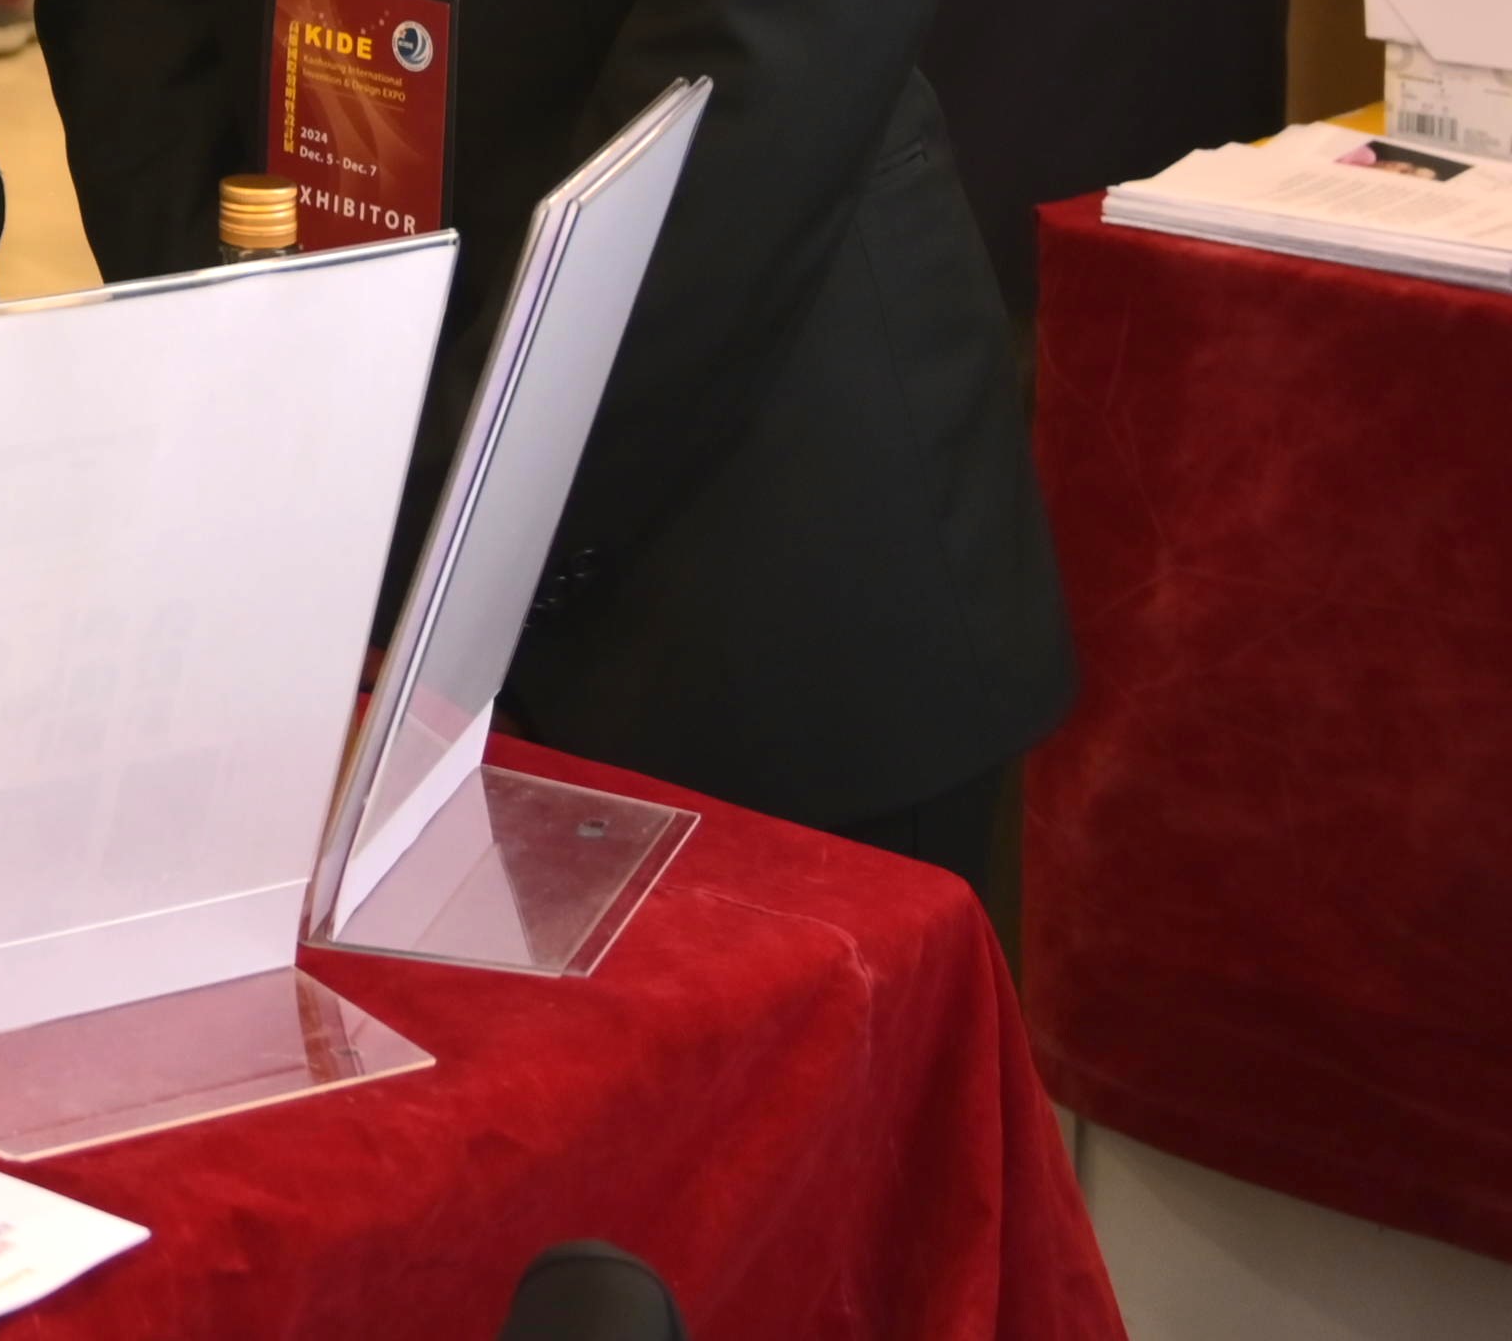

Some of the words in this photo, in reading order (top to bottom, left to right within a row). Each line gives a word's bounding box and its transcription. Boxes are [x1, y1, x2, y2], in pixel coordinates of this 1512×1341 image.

[304, 23, 373, 60] KIDE
[300, 126, 328, 144] 2024
[299, 144, 324, 164] Dec.
[326, 153, 334, 166] 5
[342, 157, 367, 176] Dec.
[370, 164, 377, 178] 7
[300, 185, 417, 236] XHIBITOR
